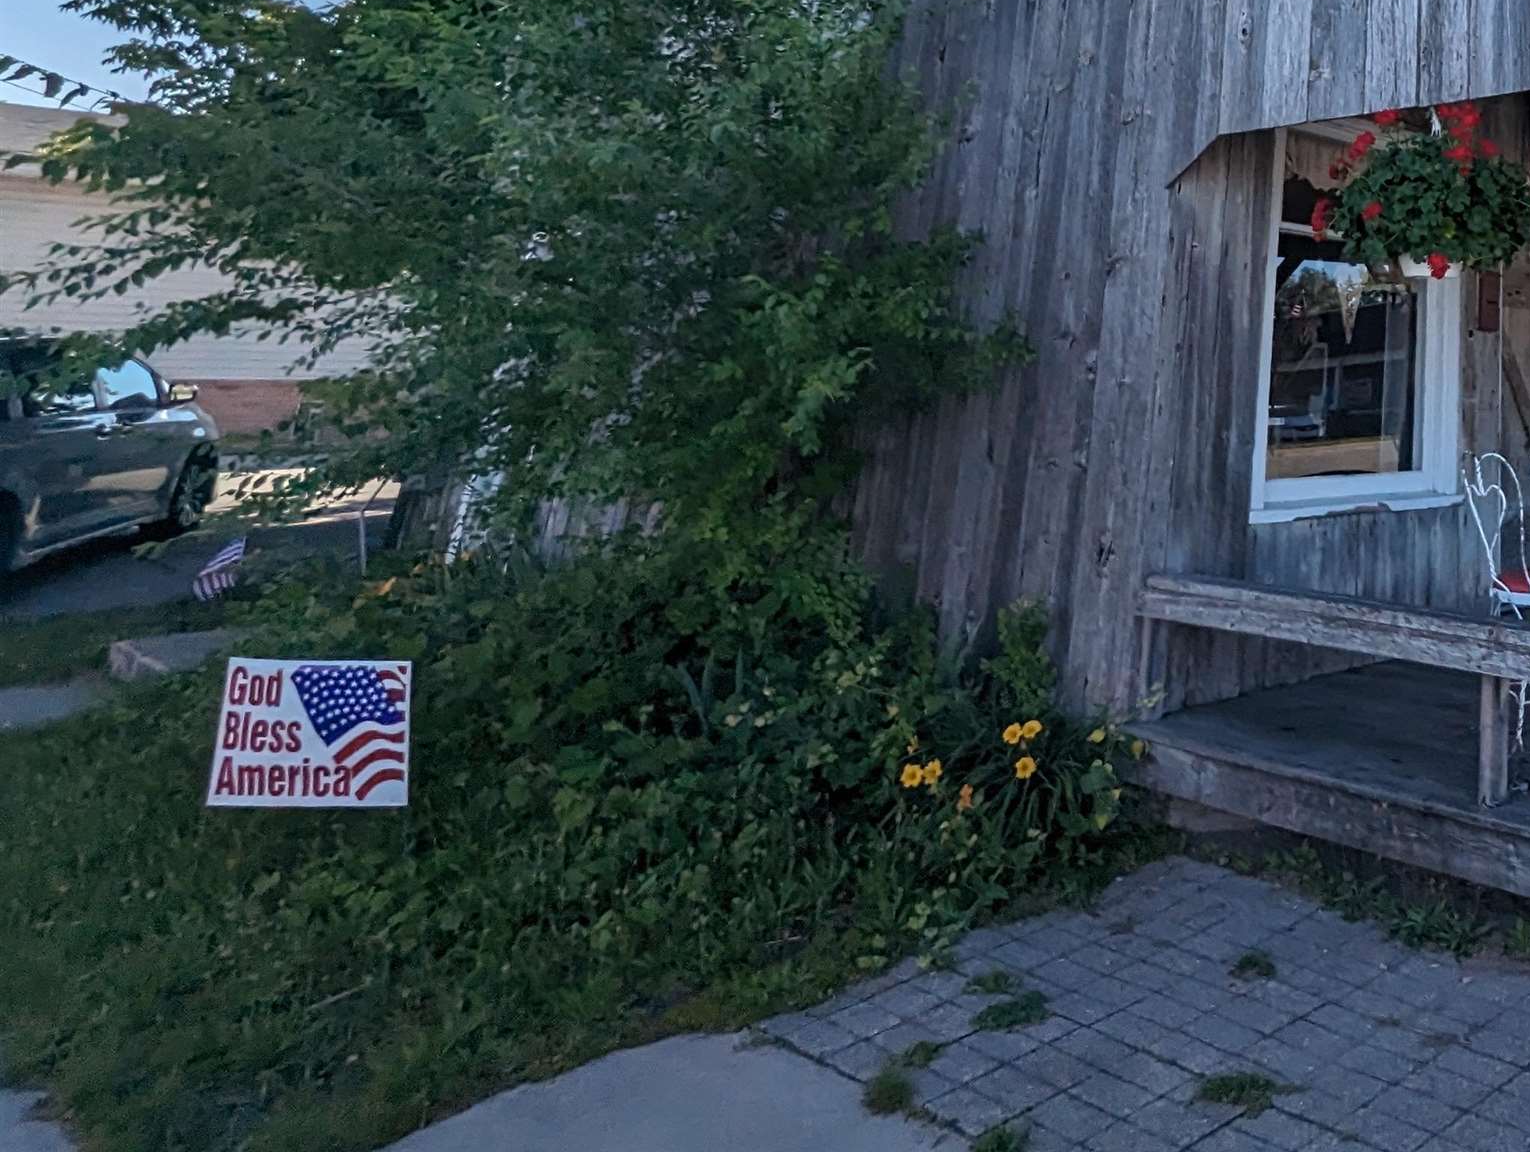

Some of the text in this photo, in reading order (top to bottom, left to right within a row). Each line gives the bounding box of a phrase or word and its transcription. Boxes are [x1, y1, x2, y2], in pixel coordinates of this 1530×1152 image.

[228, 665, 284, 707] God
[222, 711, 303, 753] Bless
[214, 756, 351, 797] America
